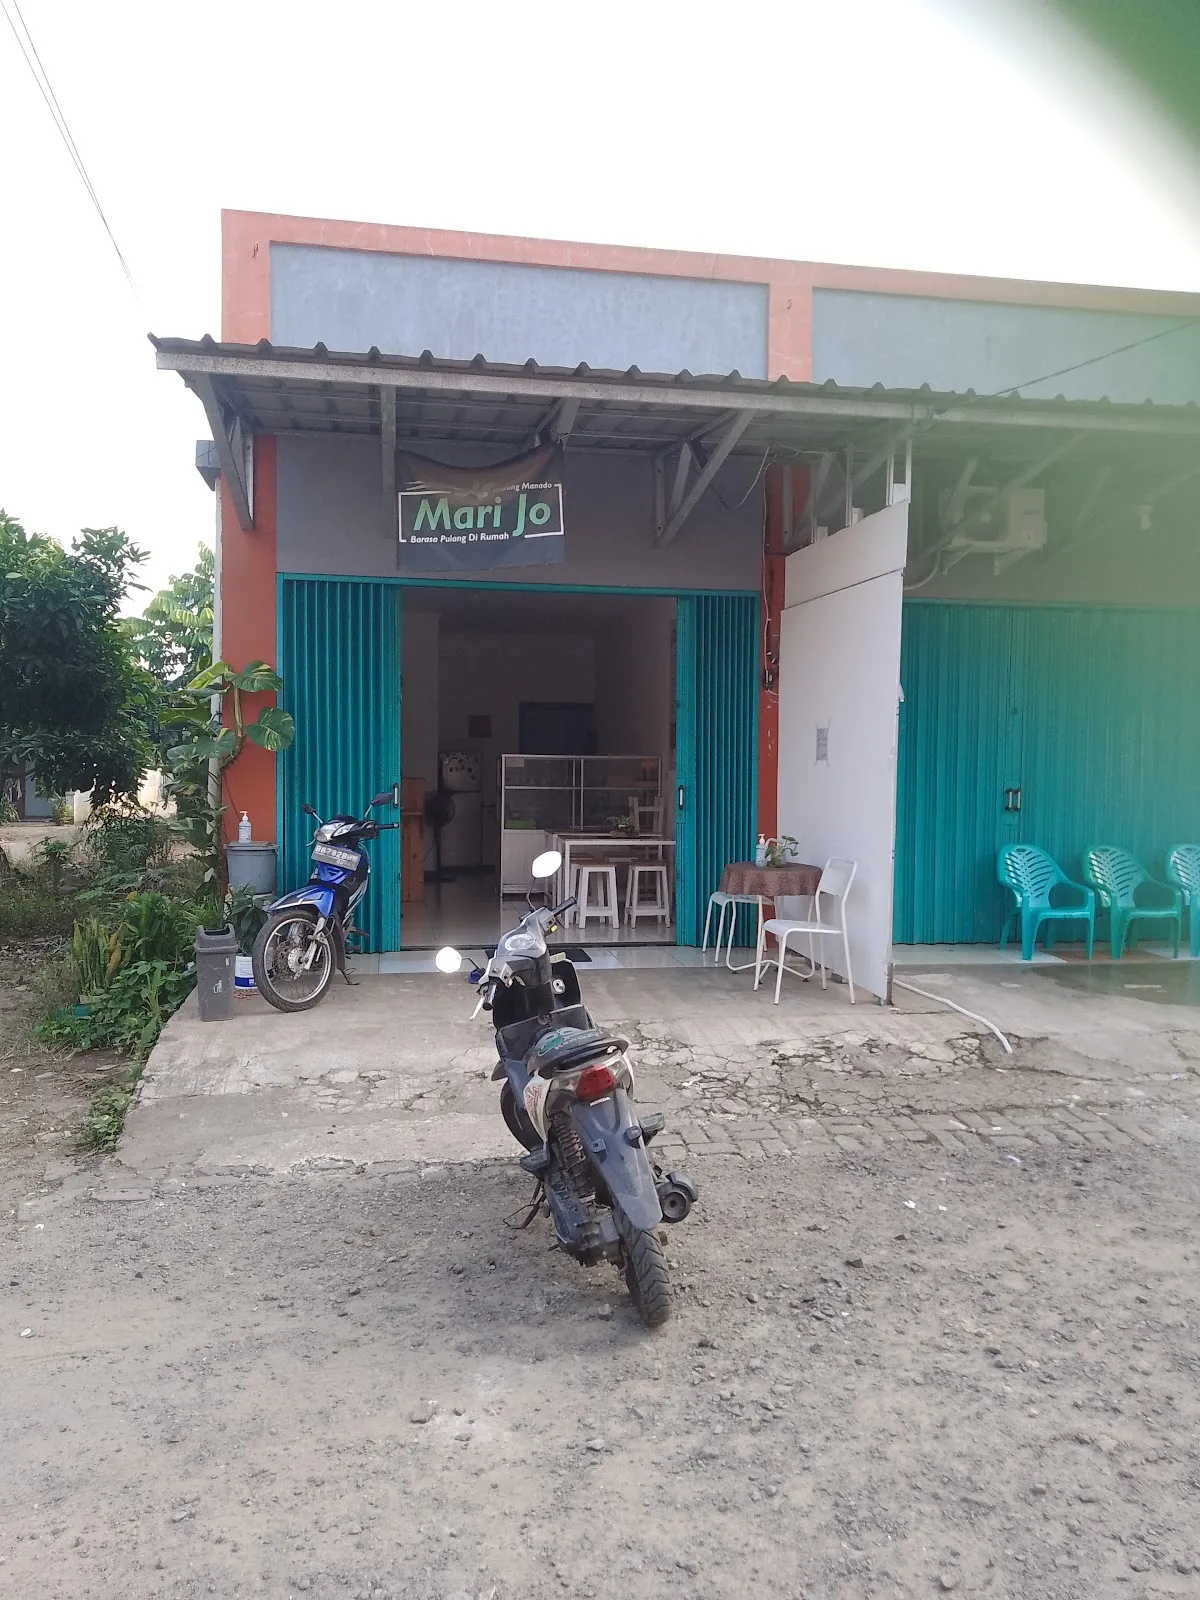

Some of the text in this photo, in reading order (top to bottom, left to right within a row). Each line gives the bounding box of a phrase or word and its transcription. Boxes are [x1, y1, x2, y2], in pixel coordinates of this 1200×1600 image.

[522, 481, 553, 490] Manado
[413, 493, 551, 537] Mari Jo
[410, 531, 510, 544] Barasa Pulang Di Rumah
